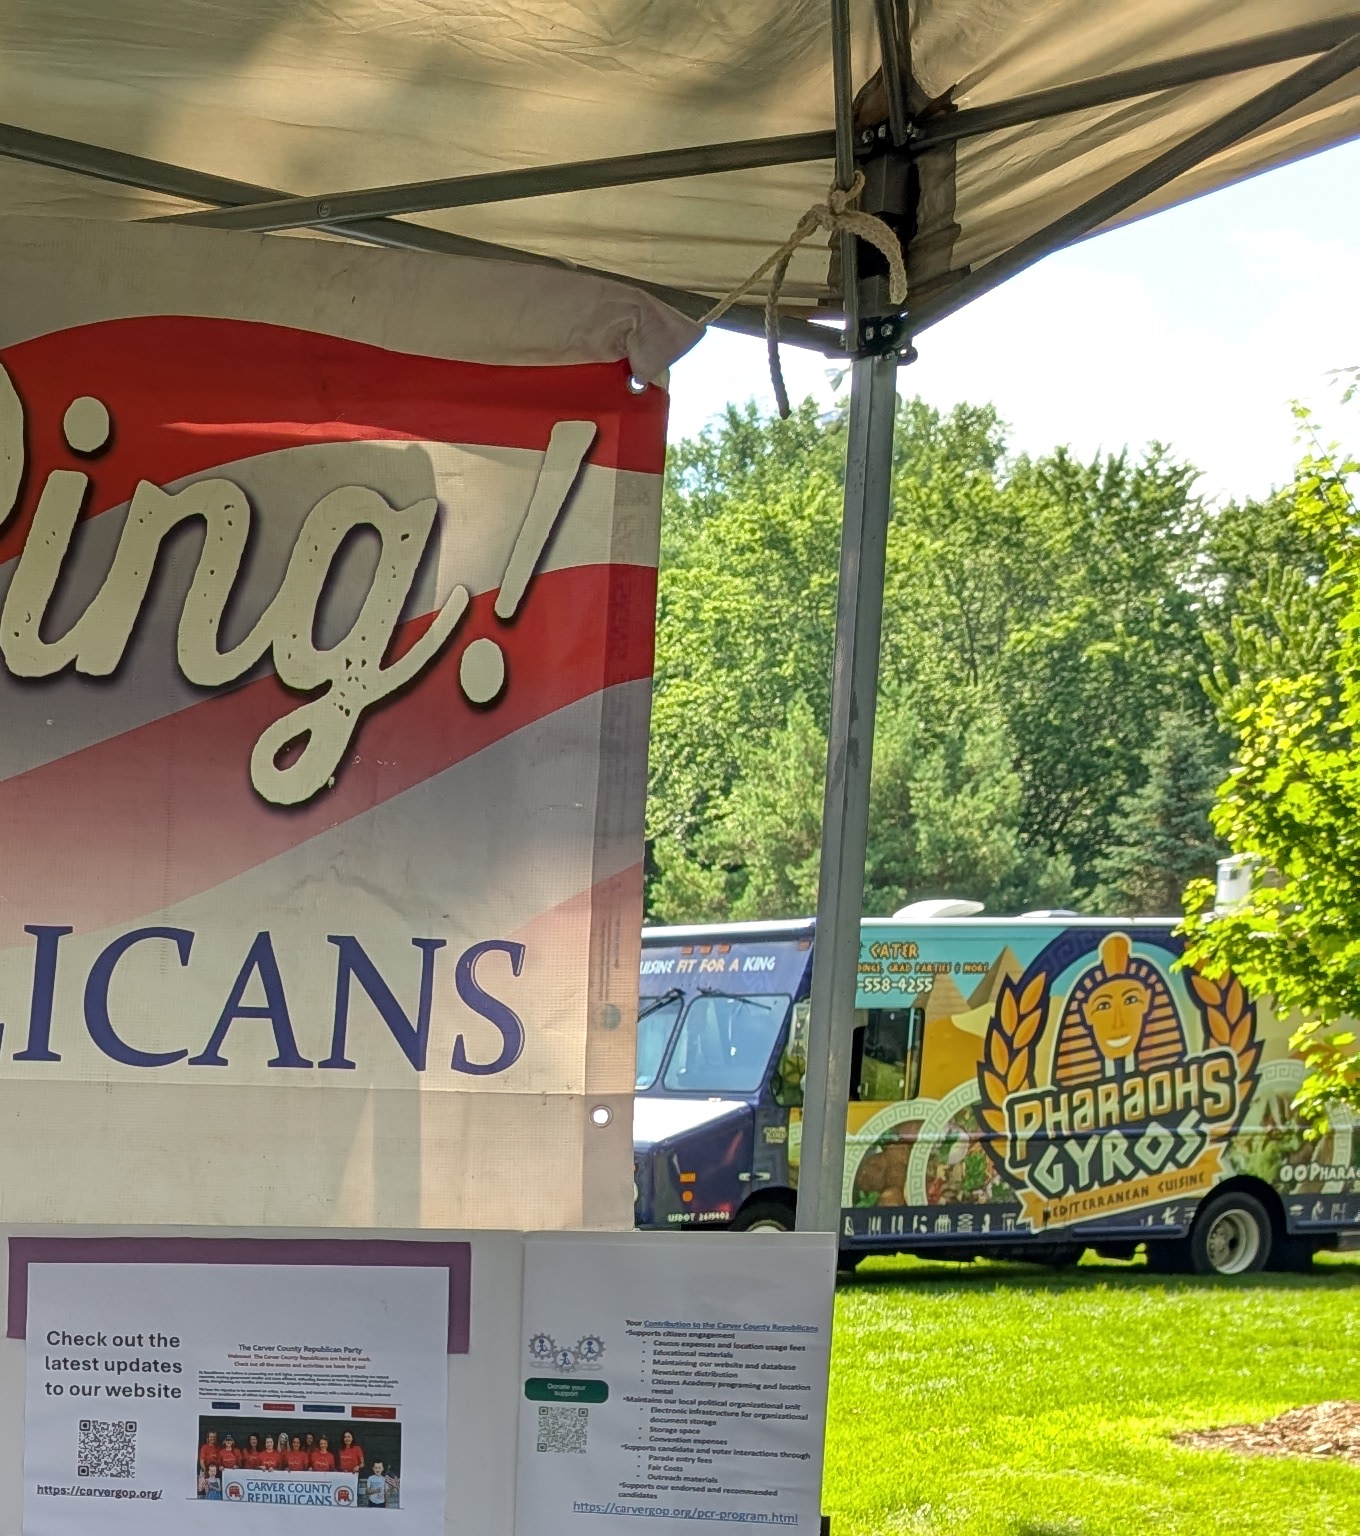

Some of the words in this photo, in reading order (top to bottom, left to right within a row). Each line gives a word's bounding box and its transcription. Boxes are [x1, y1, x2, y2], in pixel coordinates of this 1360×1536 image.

[870, 942, 920, 960] CATER
[677, 959, 698, 973] FIT
[700, 959, 725, 972] FOR
[729, 959, 740, 972] A
[743, 956, 776, 972] KING
[1013, 1057, 1232, 1162] PHARAOHS
[1033, 1109, 1206, 1195] GYROS
[1158, 1172, 1204, 1199] CUISINE
[46, 1330, 108, 1347] Check
[112, 1332, 144, 1348] out
[148, 1333, 181, 1349] the
[277, 1345, 302, 1354] County
[303, 1346, 342, 1354] Republican
[344, 1347, 362, 1355] Party
[45, 1356, 100, 1373] latest
[103, 1358, 183, 1377] updates
[44, 1382, 64, 1397] to
[68, 1385, 99, 1398] our
[103, 1382, 182, 1399] website
[247, 1482, 285, 1493] CARVER
[288, 1483, 332, 1494] COUNTY
[247, 1492, 332, 1506] REPUBLICANS
